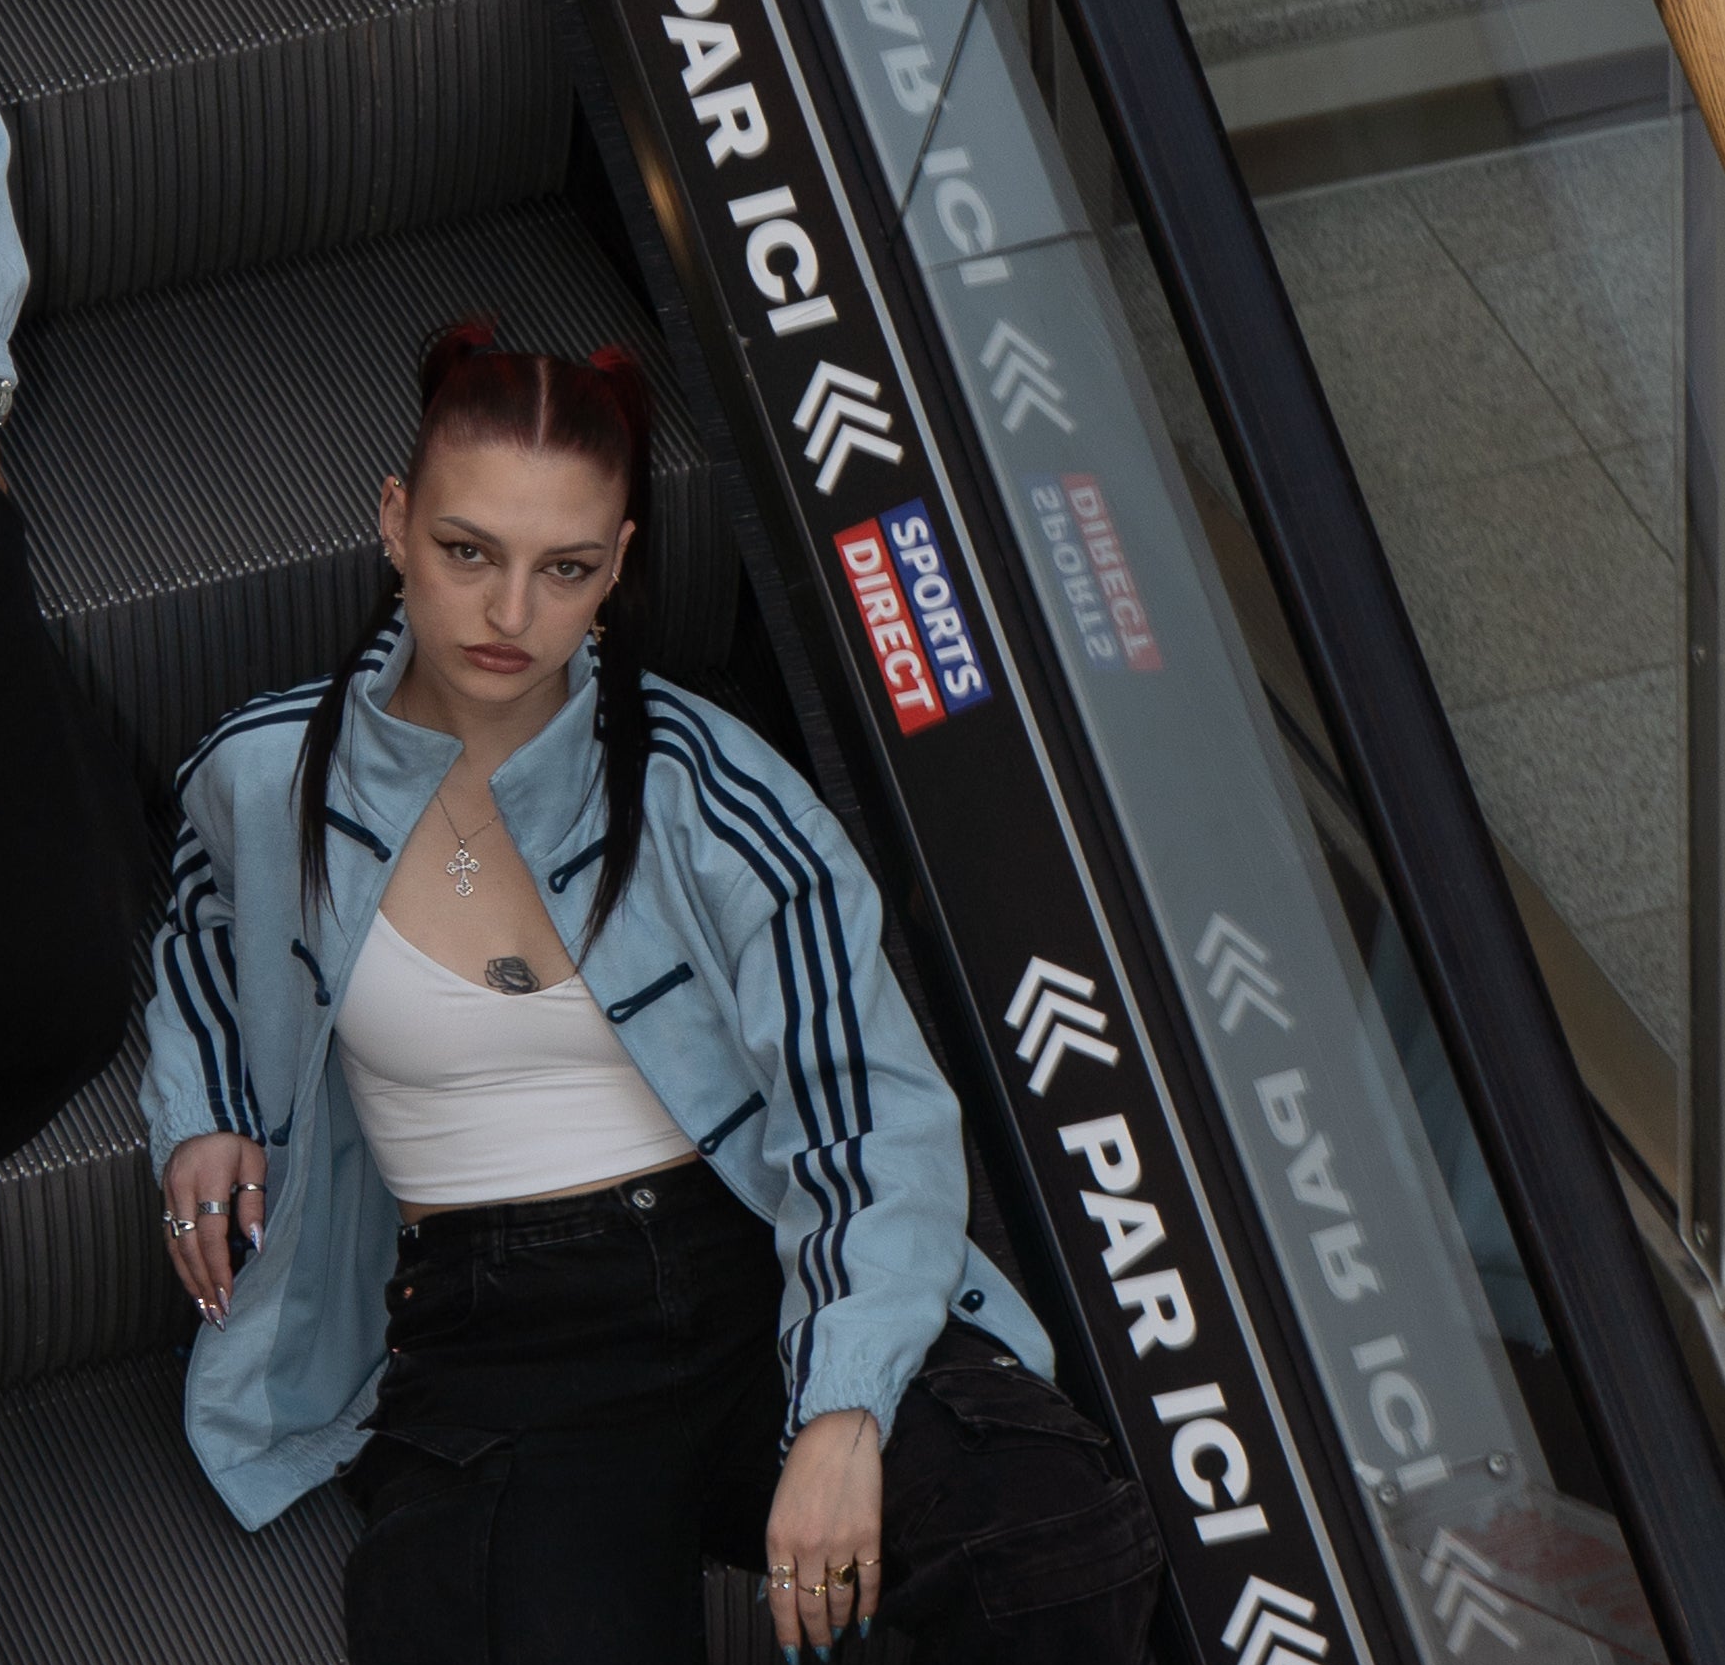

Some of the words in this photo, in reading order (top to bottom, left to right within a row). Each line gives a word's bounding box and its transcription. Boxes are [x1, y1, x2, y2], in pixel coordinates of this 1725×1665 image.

[729, 184, 838, 338] ICI
[842, 537, 936, 713] DIRECT
[891, 516, 984, 698] SPORTS
[1058, 1114, 1196, 1358] PAR
[1151, 1382, 1271, 1546] ICI
